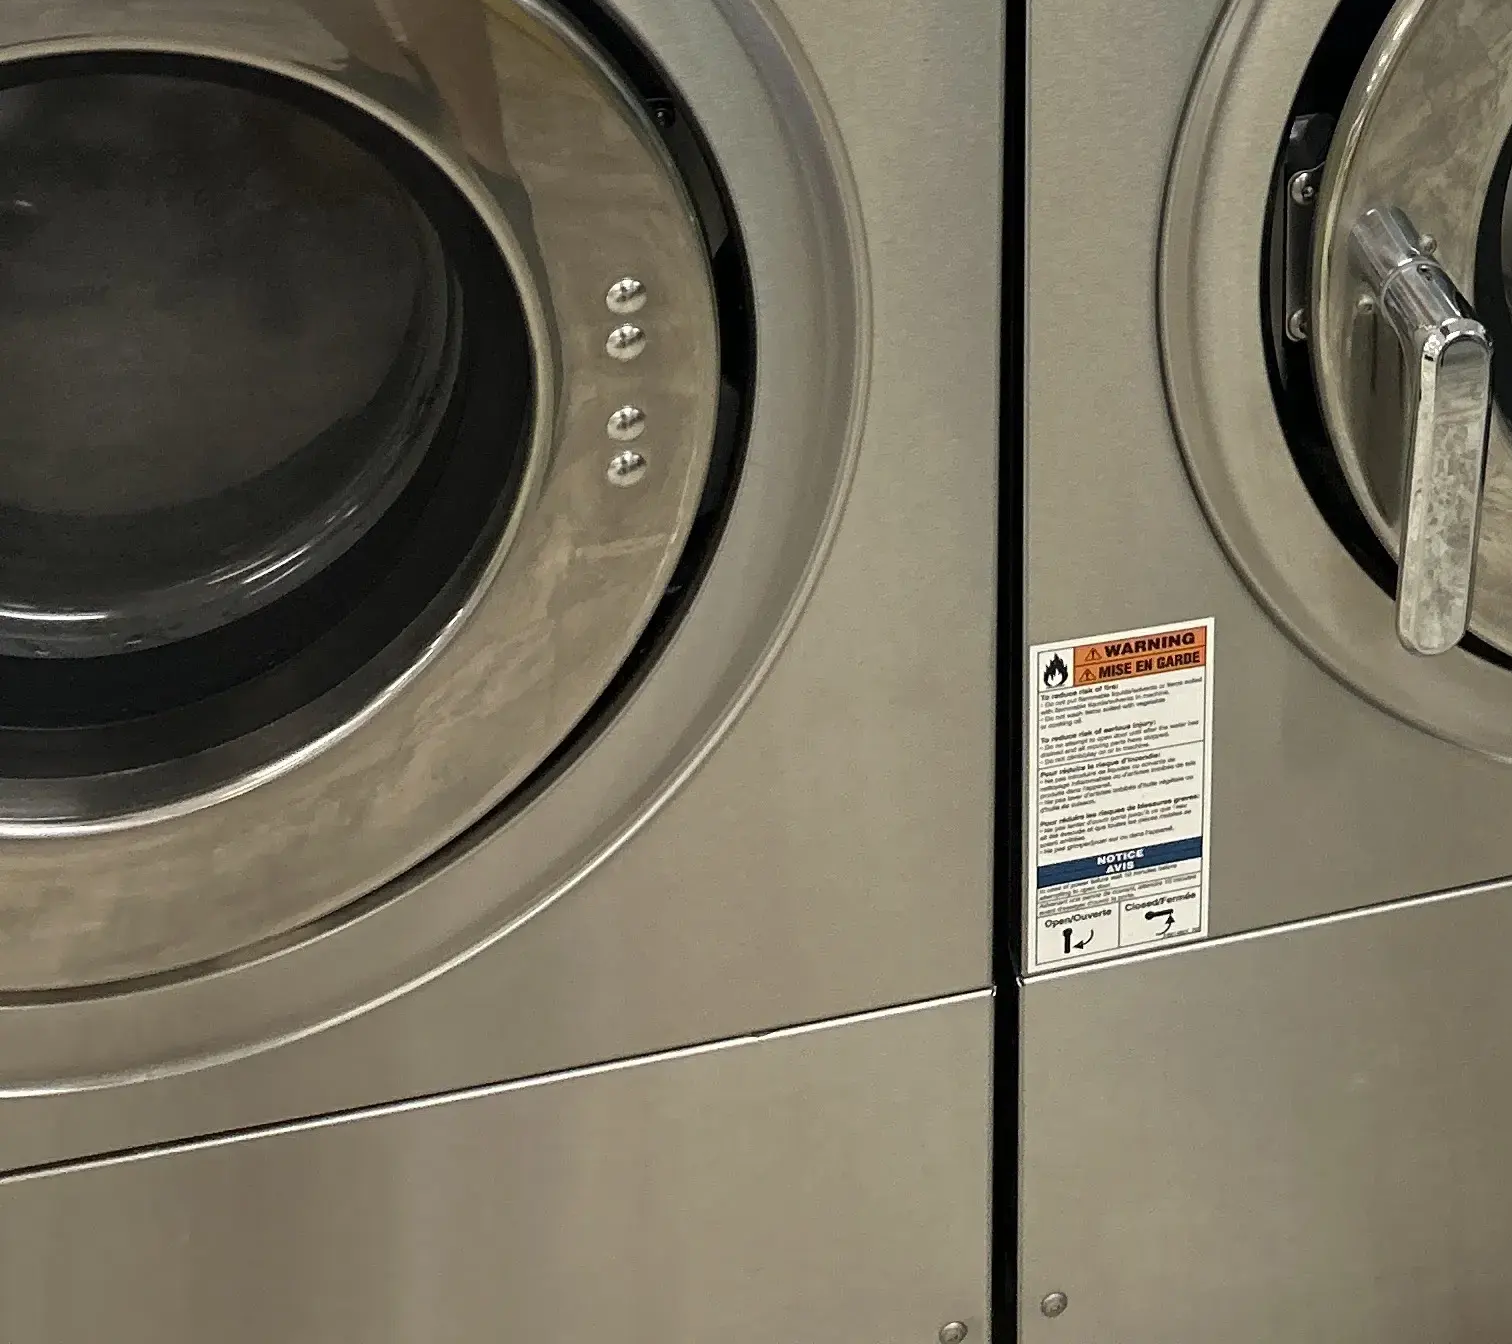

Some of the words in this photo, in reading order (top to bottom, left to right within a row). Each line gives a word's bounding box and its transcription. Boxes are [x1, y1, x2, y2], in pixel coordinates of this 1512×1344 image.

[1104, 631, 1195, 658] WARNING
[1098, 661, 1131, 679] MISE
[1135, 658, 1152, 673] EN
[1156, 650, 1200, 669] GARDE
[1096, 847, 1145, 866] NOTICE
[1105, 859, 1134, 874] AVIS
[1124, 890, 1196, 912] Closed/Fermée
[1044, 907, 1112, 929] Open/Ouverte
